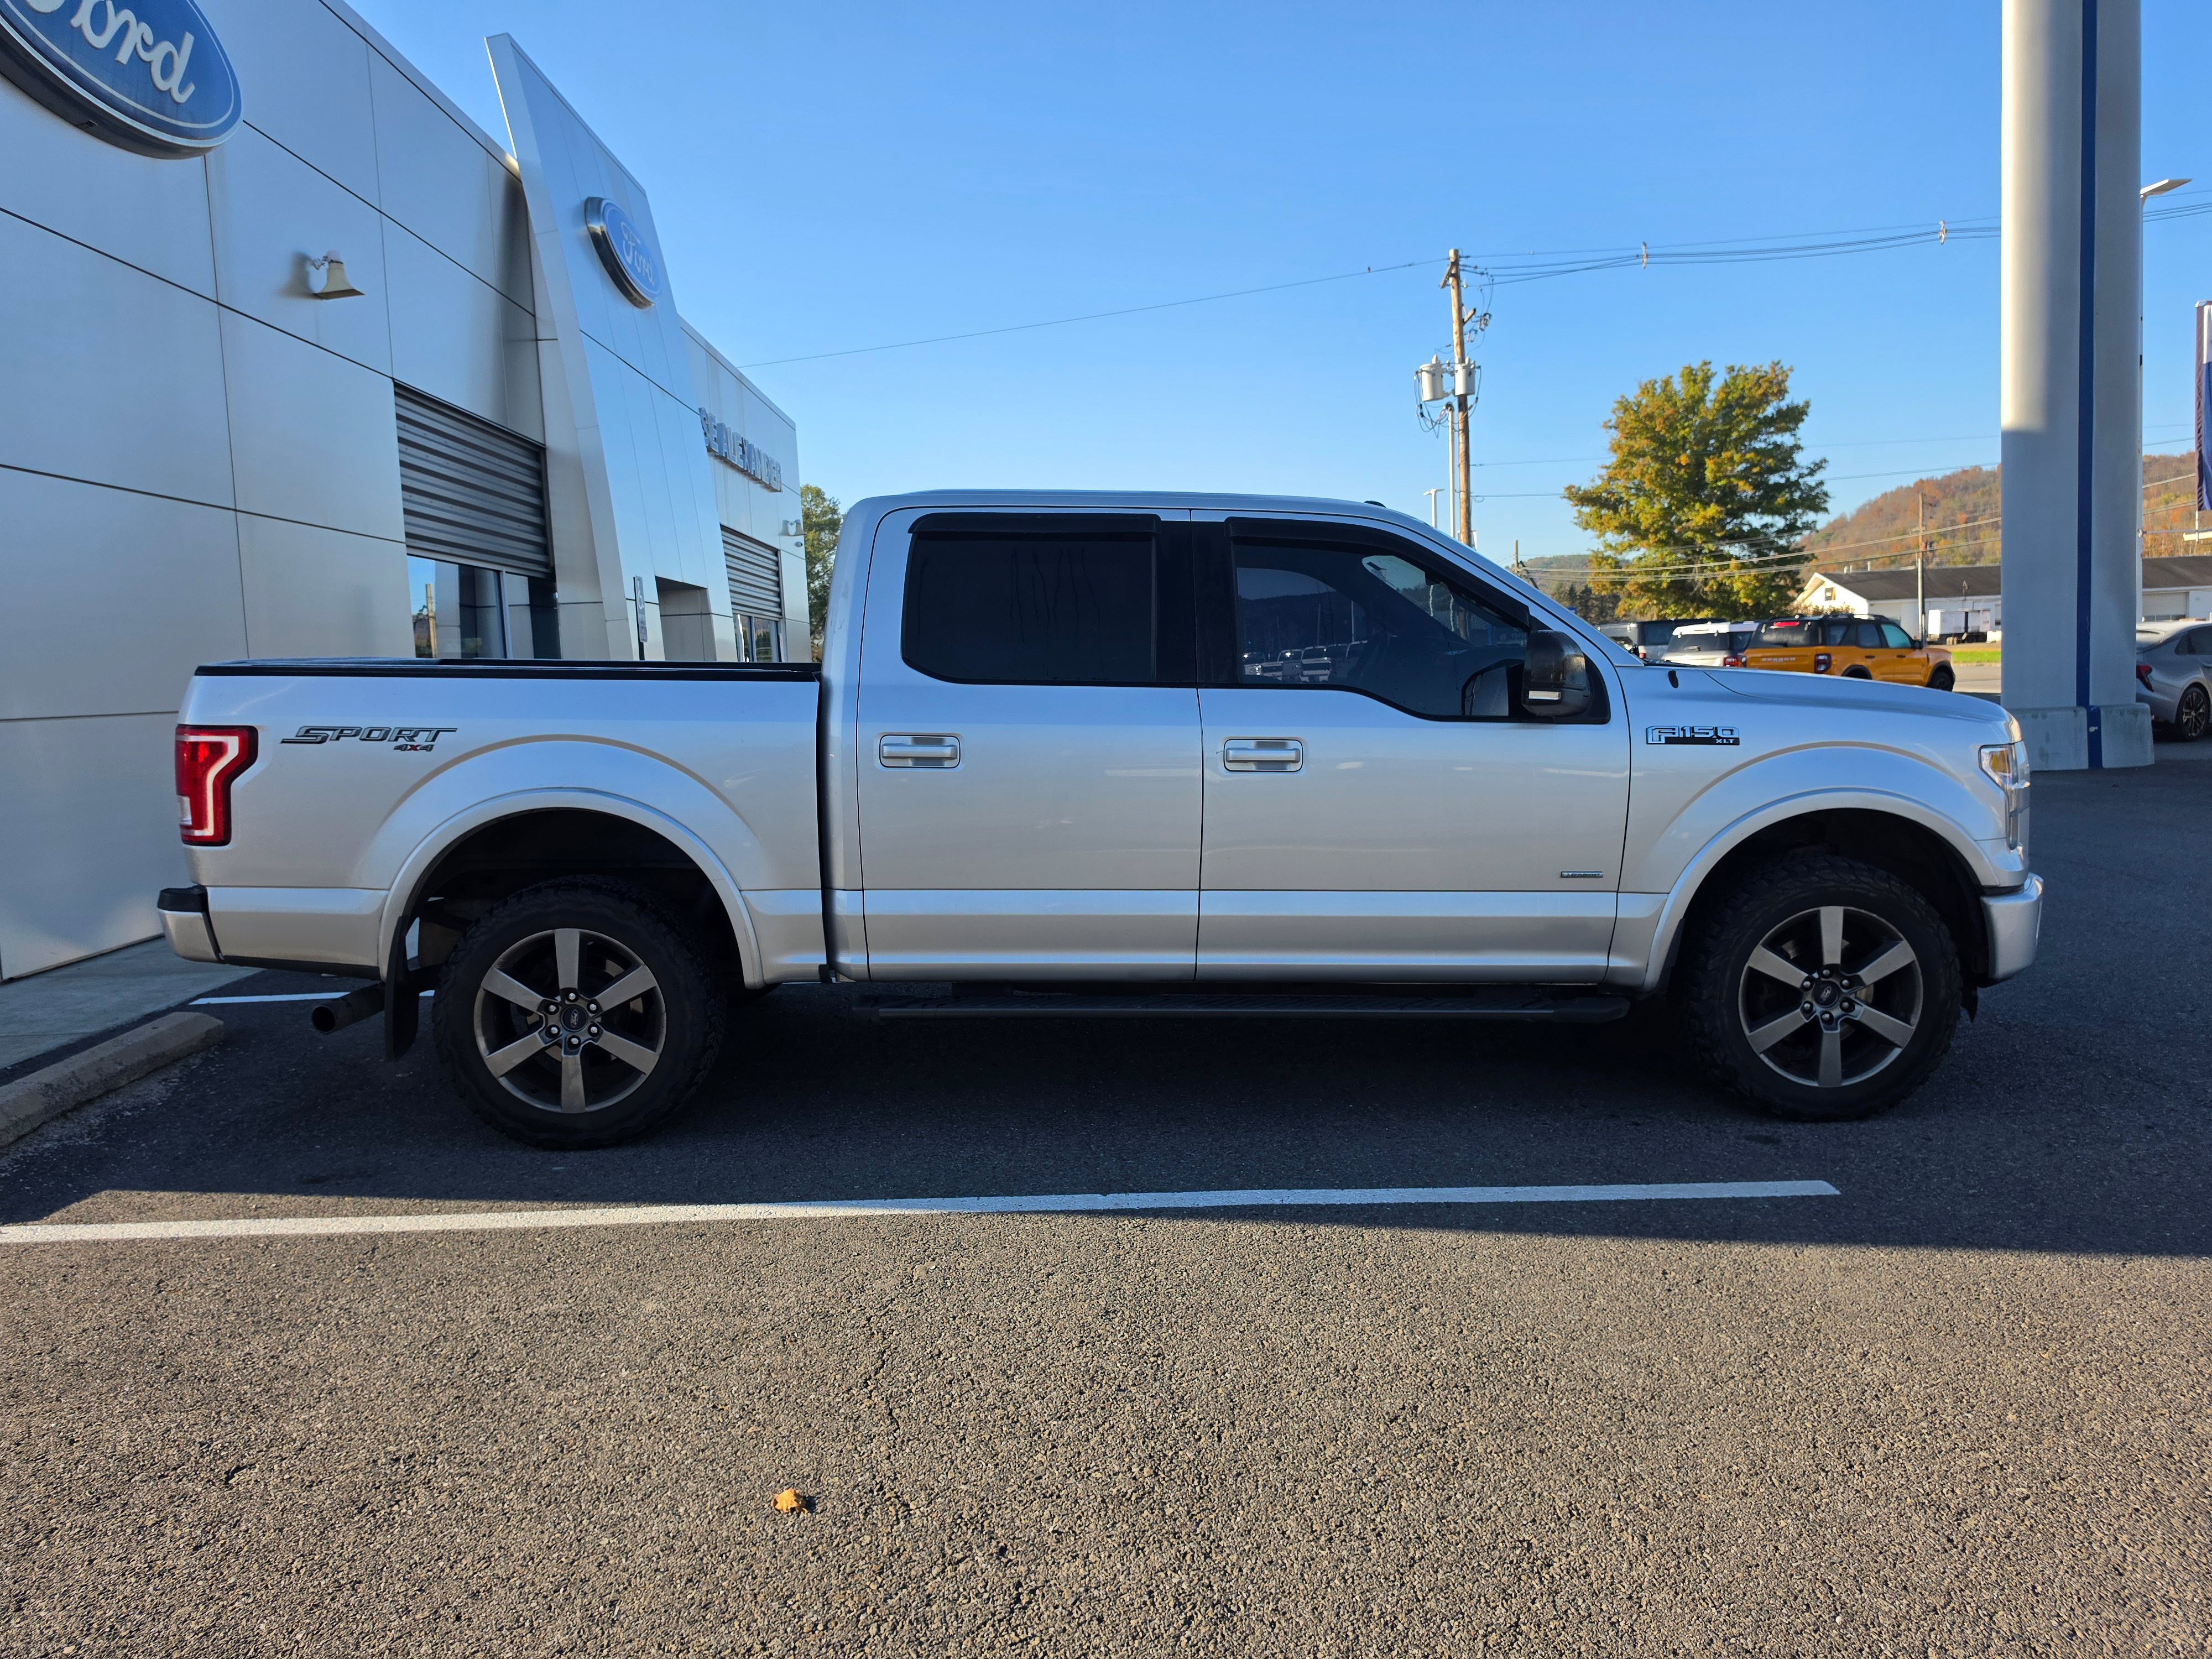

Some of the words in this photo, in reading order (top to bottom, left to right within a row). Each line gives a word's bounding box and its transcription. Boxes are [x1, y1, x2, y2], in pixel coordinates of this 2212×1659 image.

[27, 0, 195, 103] ord
[621, 221, 655, 286] Ford
[280, 726, 458, 744] SPORT
